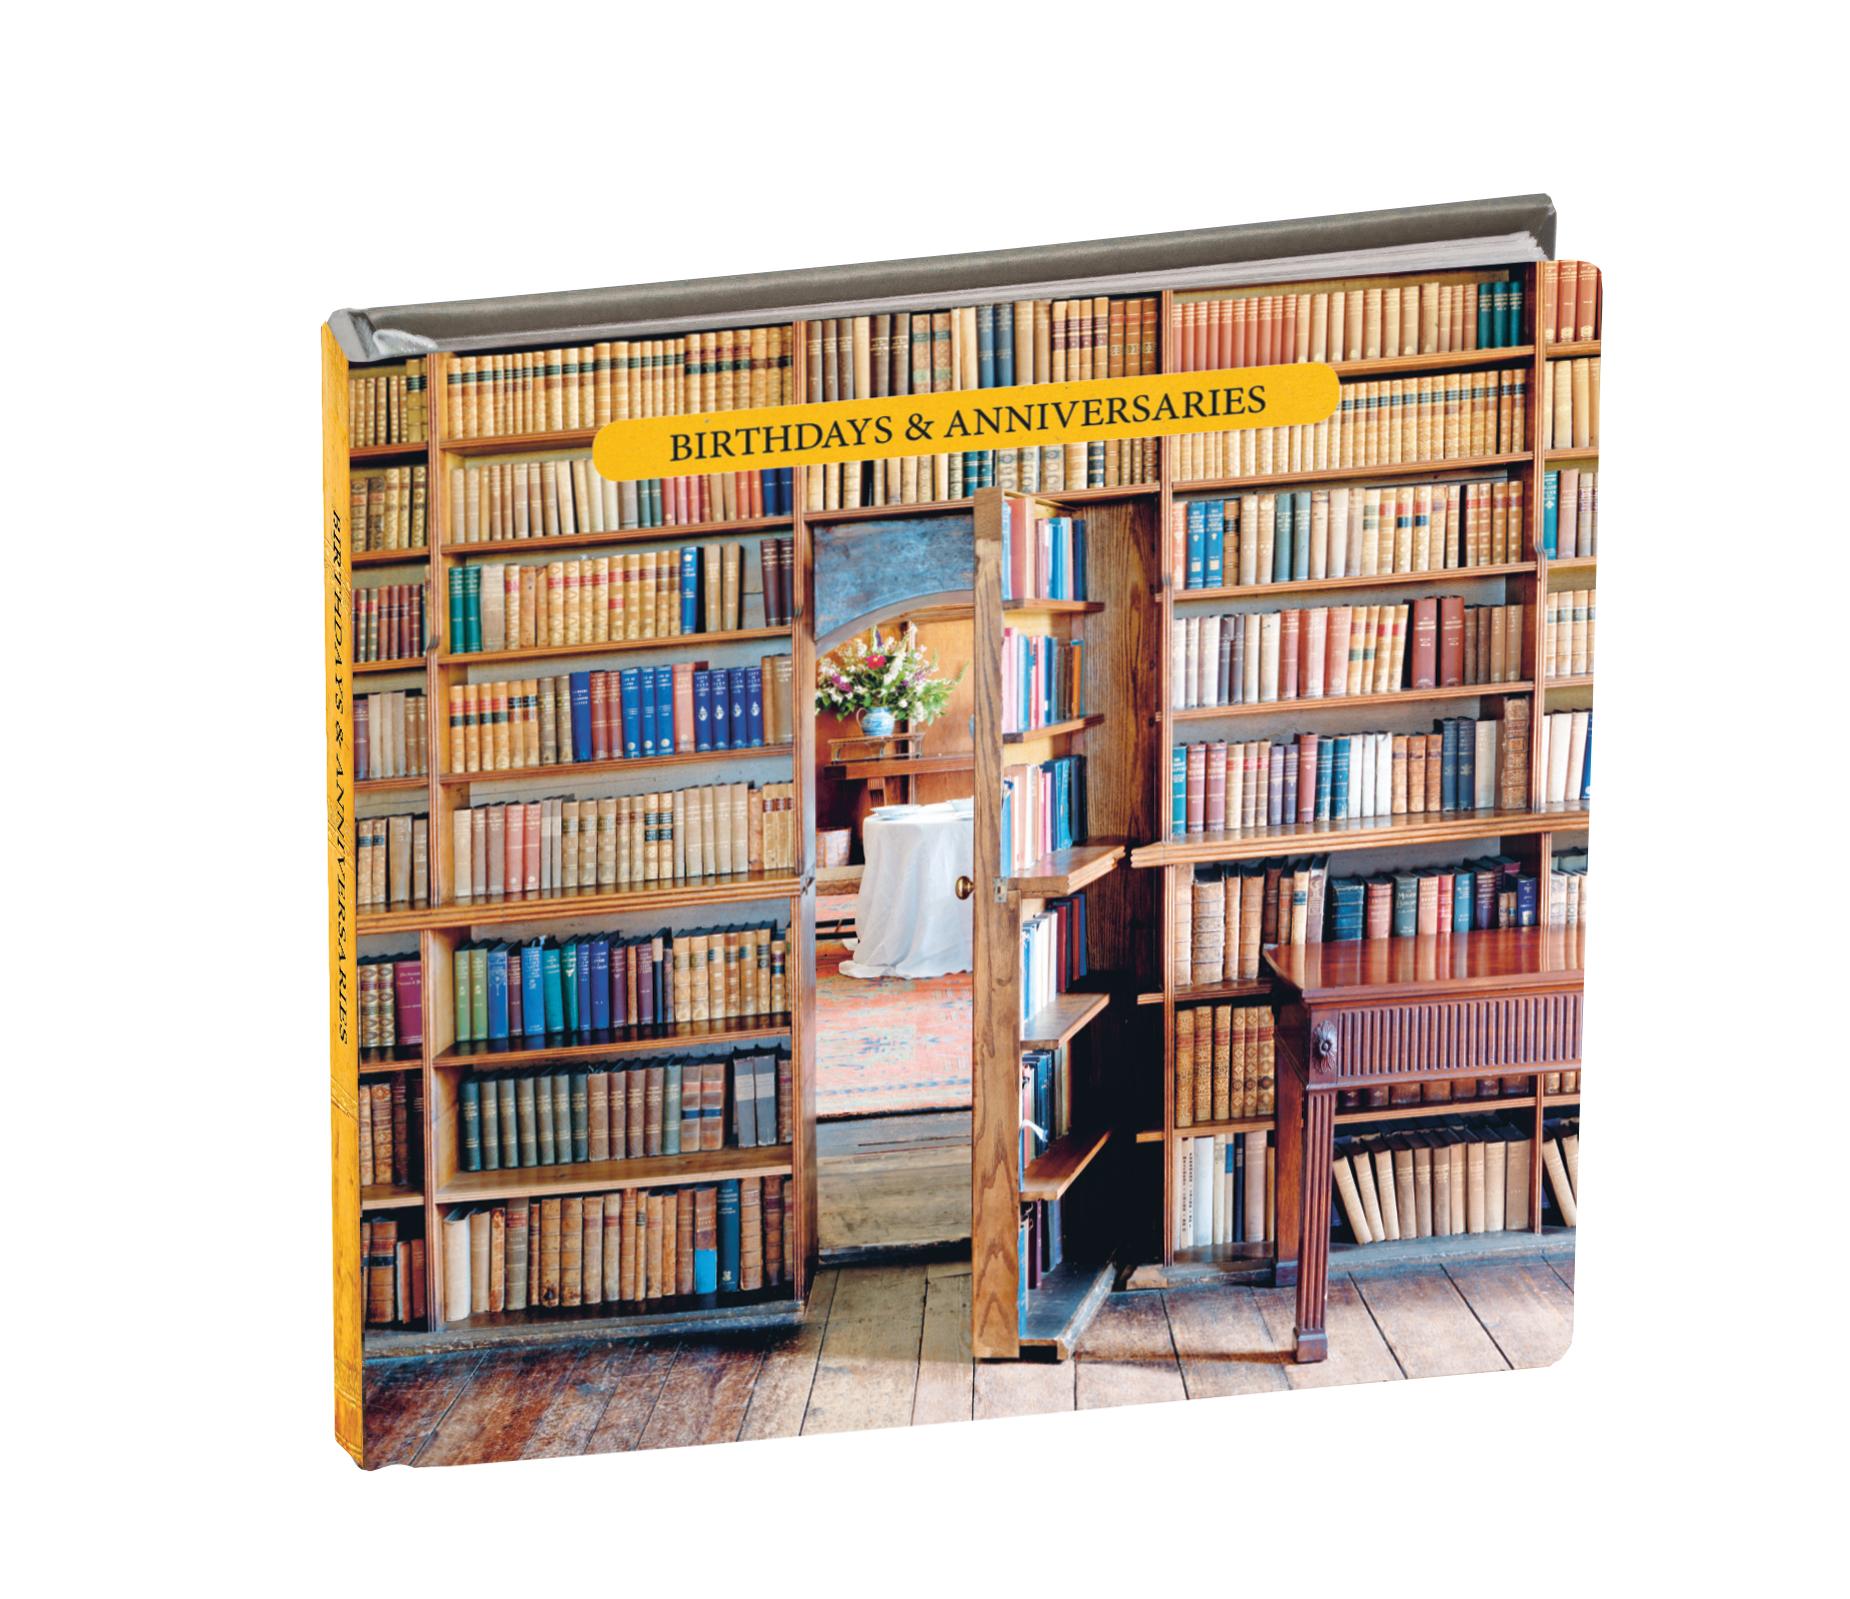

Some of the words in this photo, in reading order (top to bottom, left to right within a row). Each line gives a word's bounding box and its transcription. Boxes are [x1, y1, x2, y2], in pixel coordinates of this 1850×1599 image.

[670, 414, 893, 462] BIRTHDAYS
[905, 413, 934, 441] &
[943, 385, 1267, 438] ANNIVERSARIES
[332, 510, 345, 713] BIRTHDAYS
[336, 753, 348, 1046] ANNIVERSARIES
